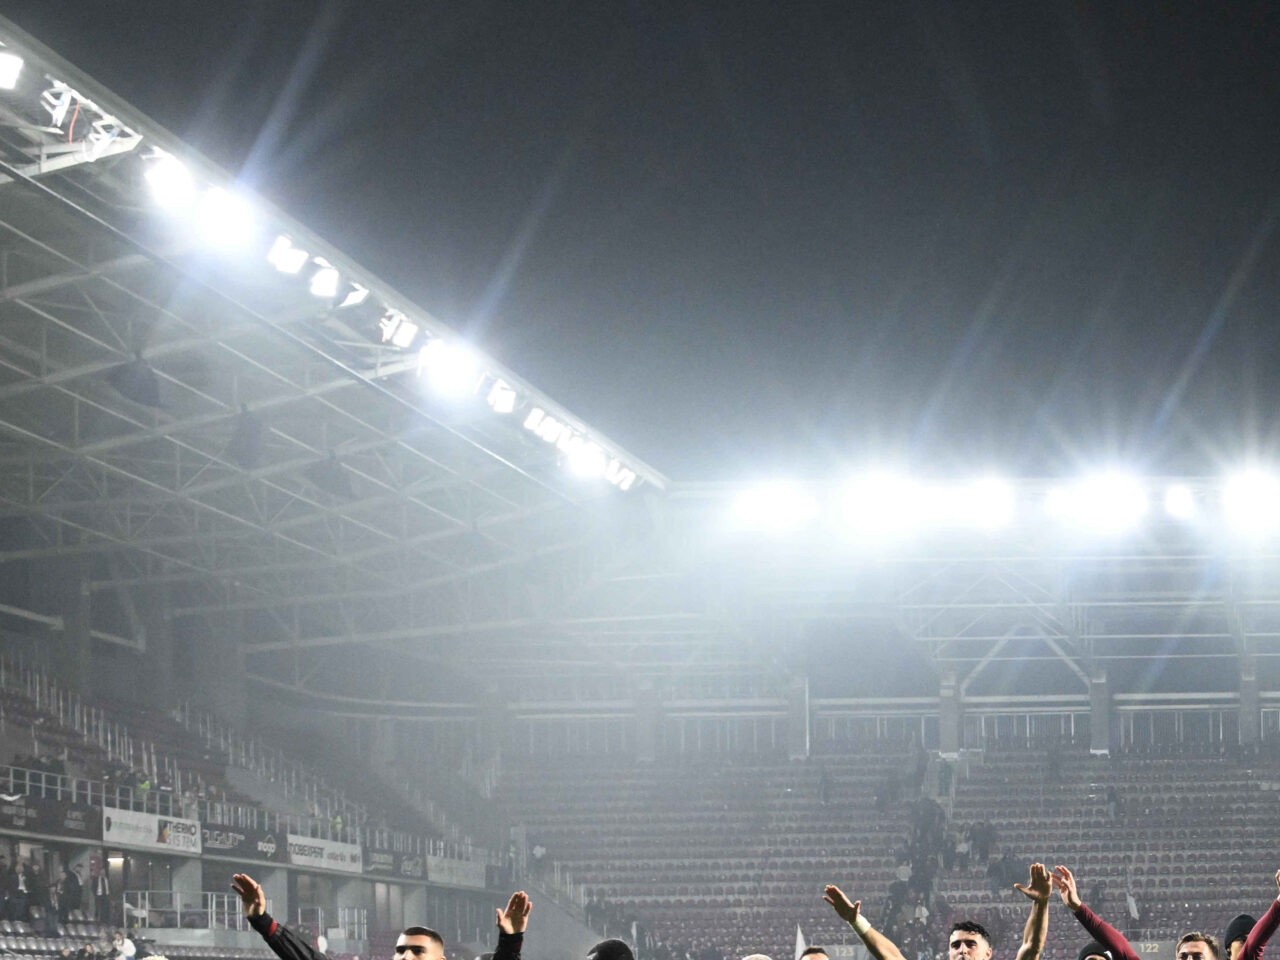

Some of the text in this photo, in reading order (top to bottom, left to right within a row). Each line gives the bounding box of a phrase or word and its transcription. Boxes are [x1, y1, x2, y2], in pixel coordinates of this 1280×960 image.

[167, 821, 197, 836] THERMO
[835, 946, 855, 957] 123
[1139, 943, 1159, 953] 122
